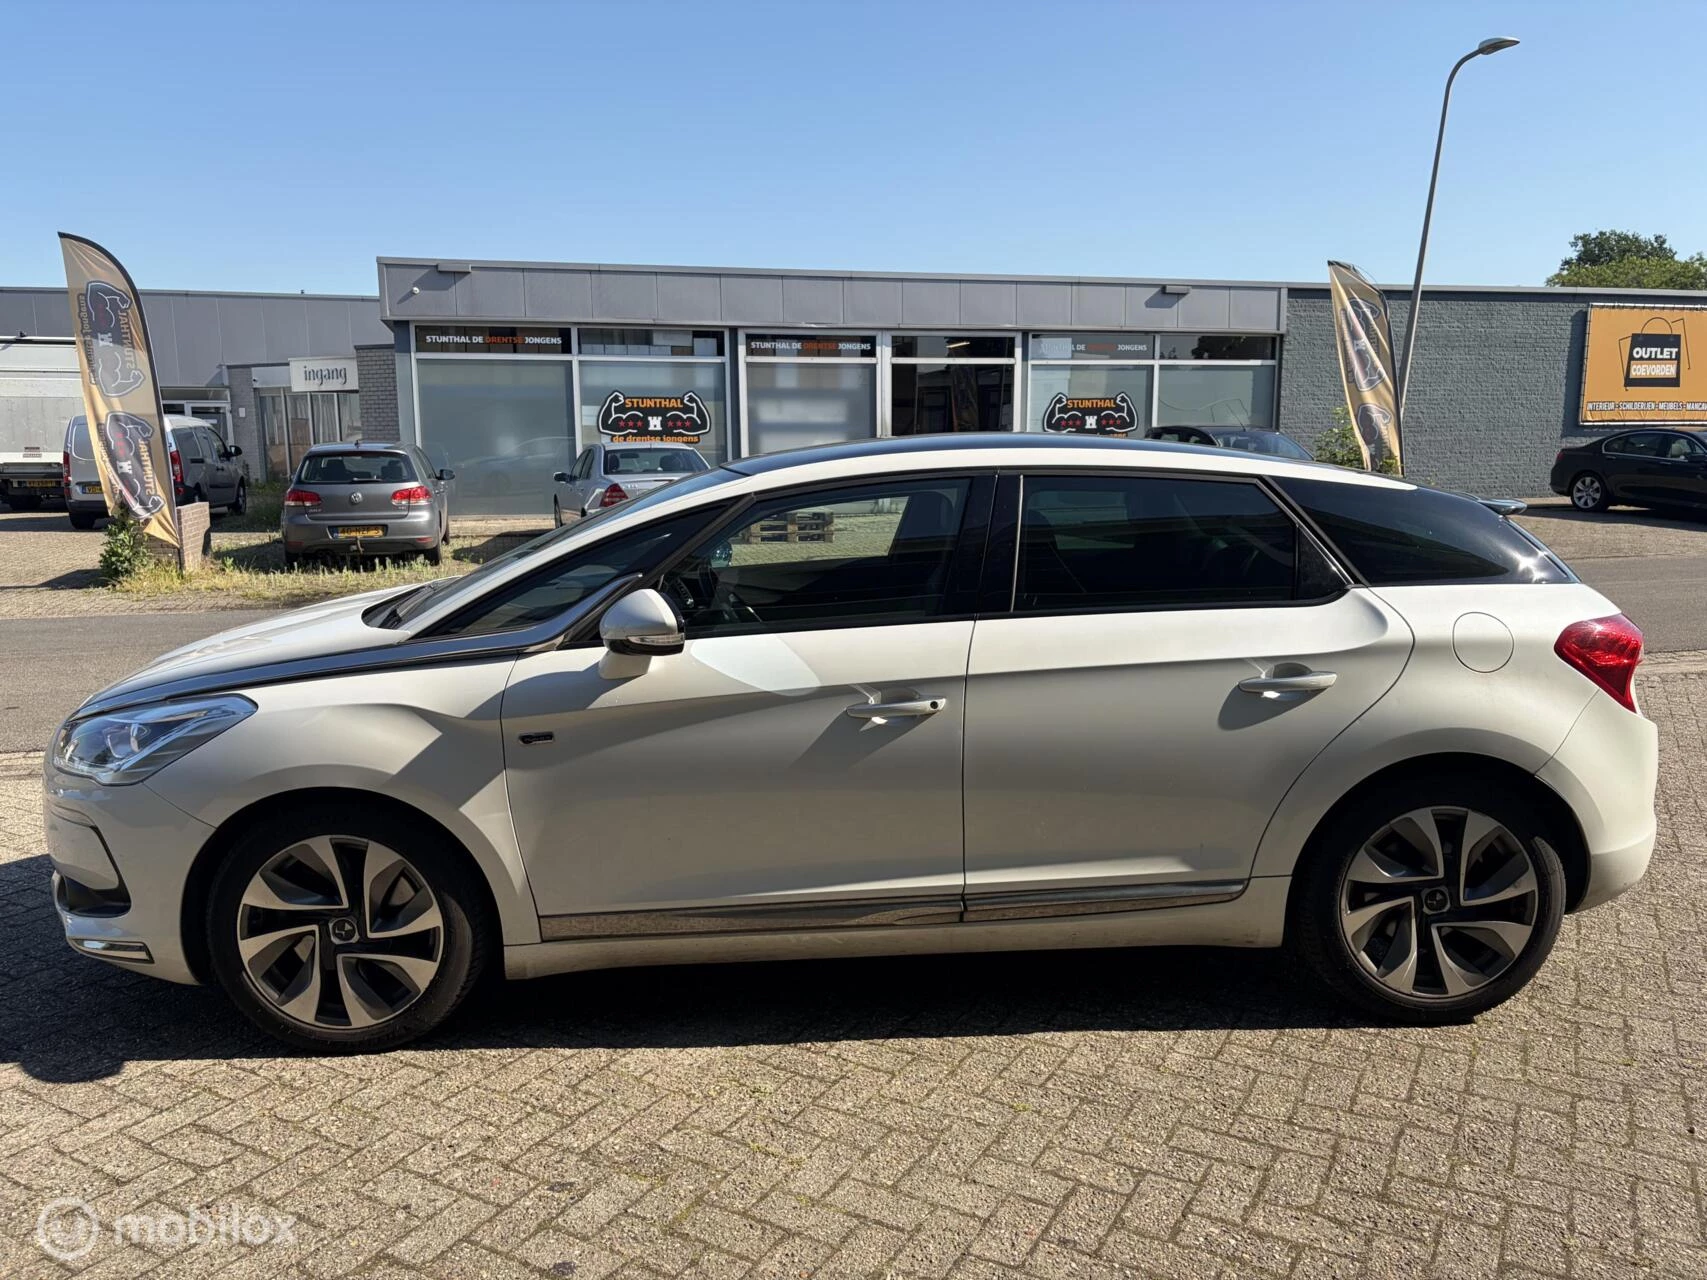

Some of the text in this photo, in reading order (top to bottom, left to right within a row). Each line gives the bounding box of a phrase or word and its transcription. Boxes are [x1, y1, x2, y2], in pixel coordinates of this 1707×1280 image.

[425, 335, 471, 344] STUNTHAL
[472, 336, 484, 344] DE
[524, 336, 562, 345] JONGENS
[750, 341, 790, 350] STUNTHAL
[792, 342, 802, 350] DE
[1633, 347, 1678, 359] OUTLET
[1631, 364, 1676, 376] COEVORDEN
[303, 365, 347, 386] ingang
[625, 398, 683, 408] STUNTHAL
[1067, 399, 1116, 408] STUNTHAL
[612, 435, 624, 443] de
[628, 435, 660, 443] drentse
